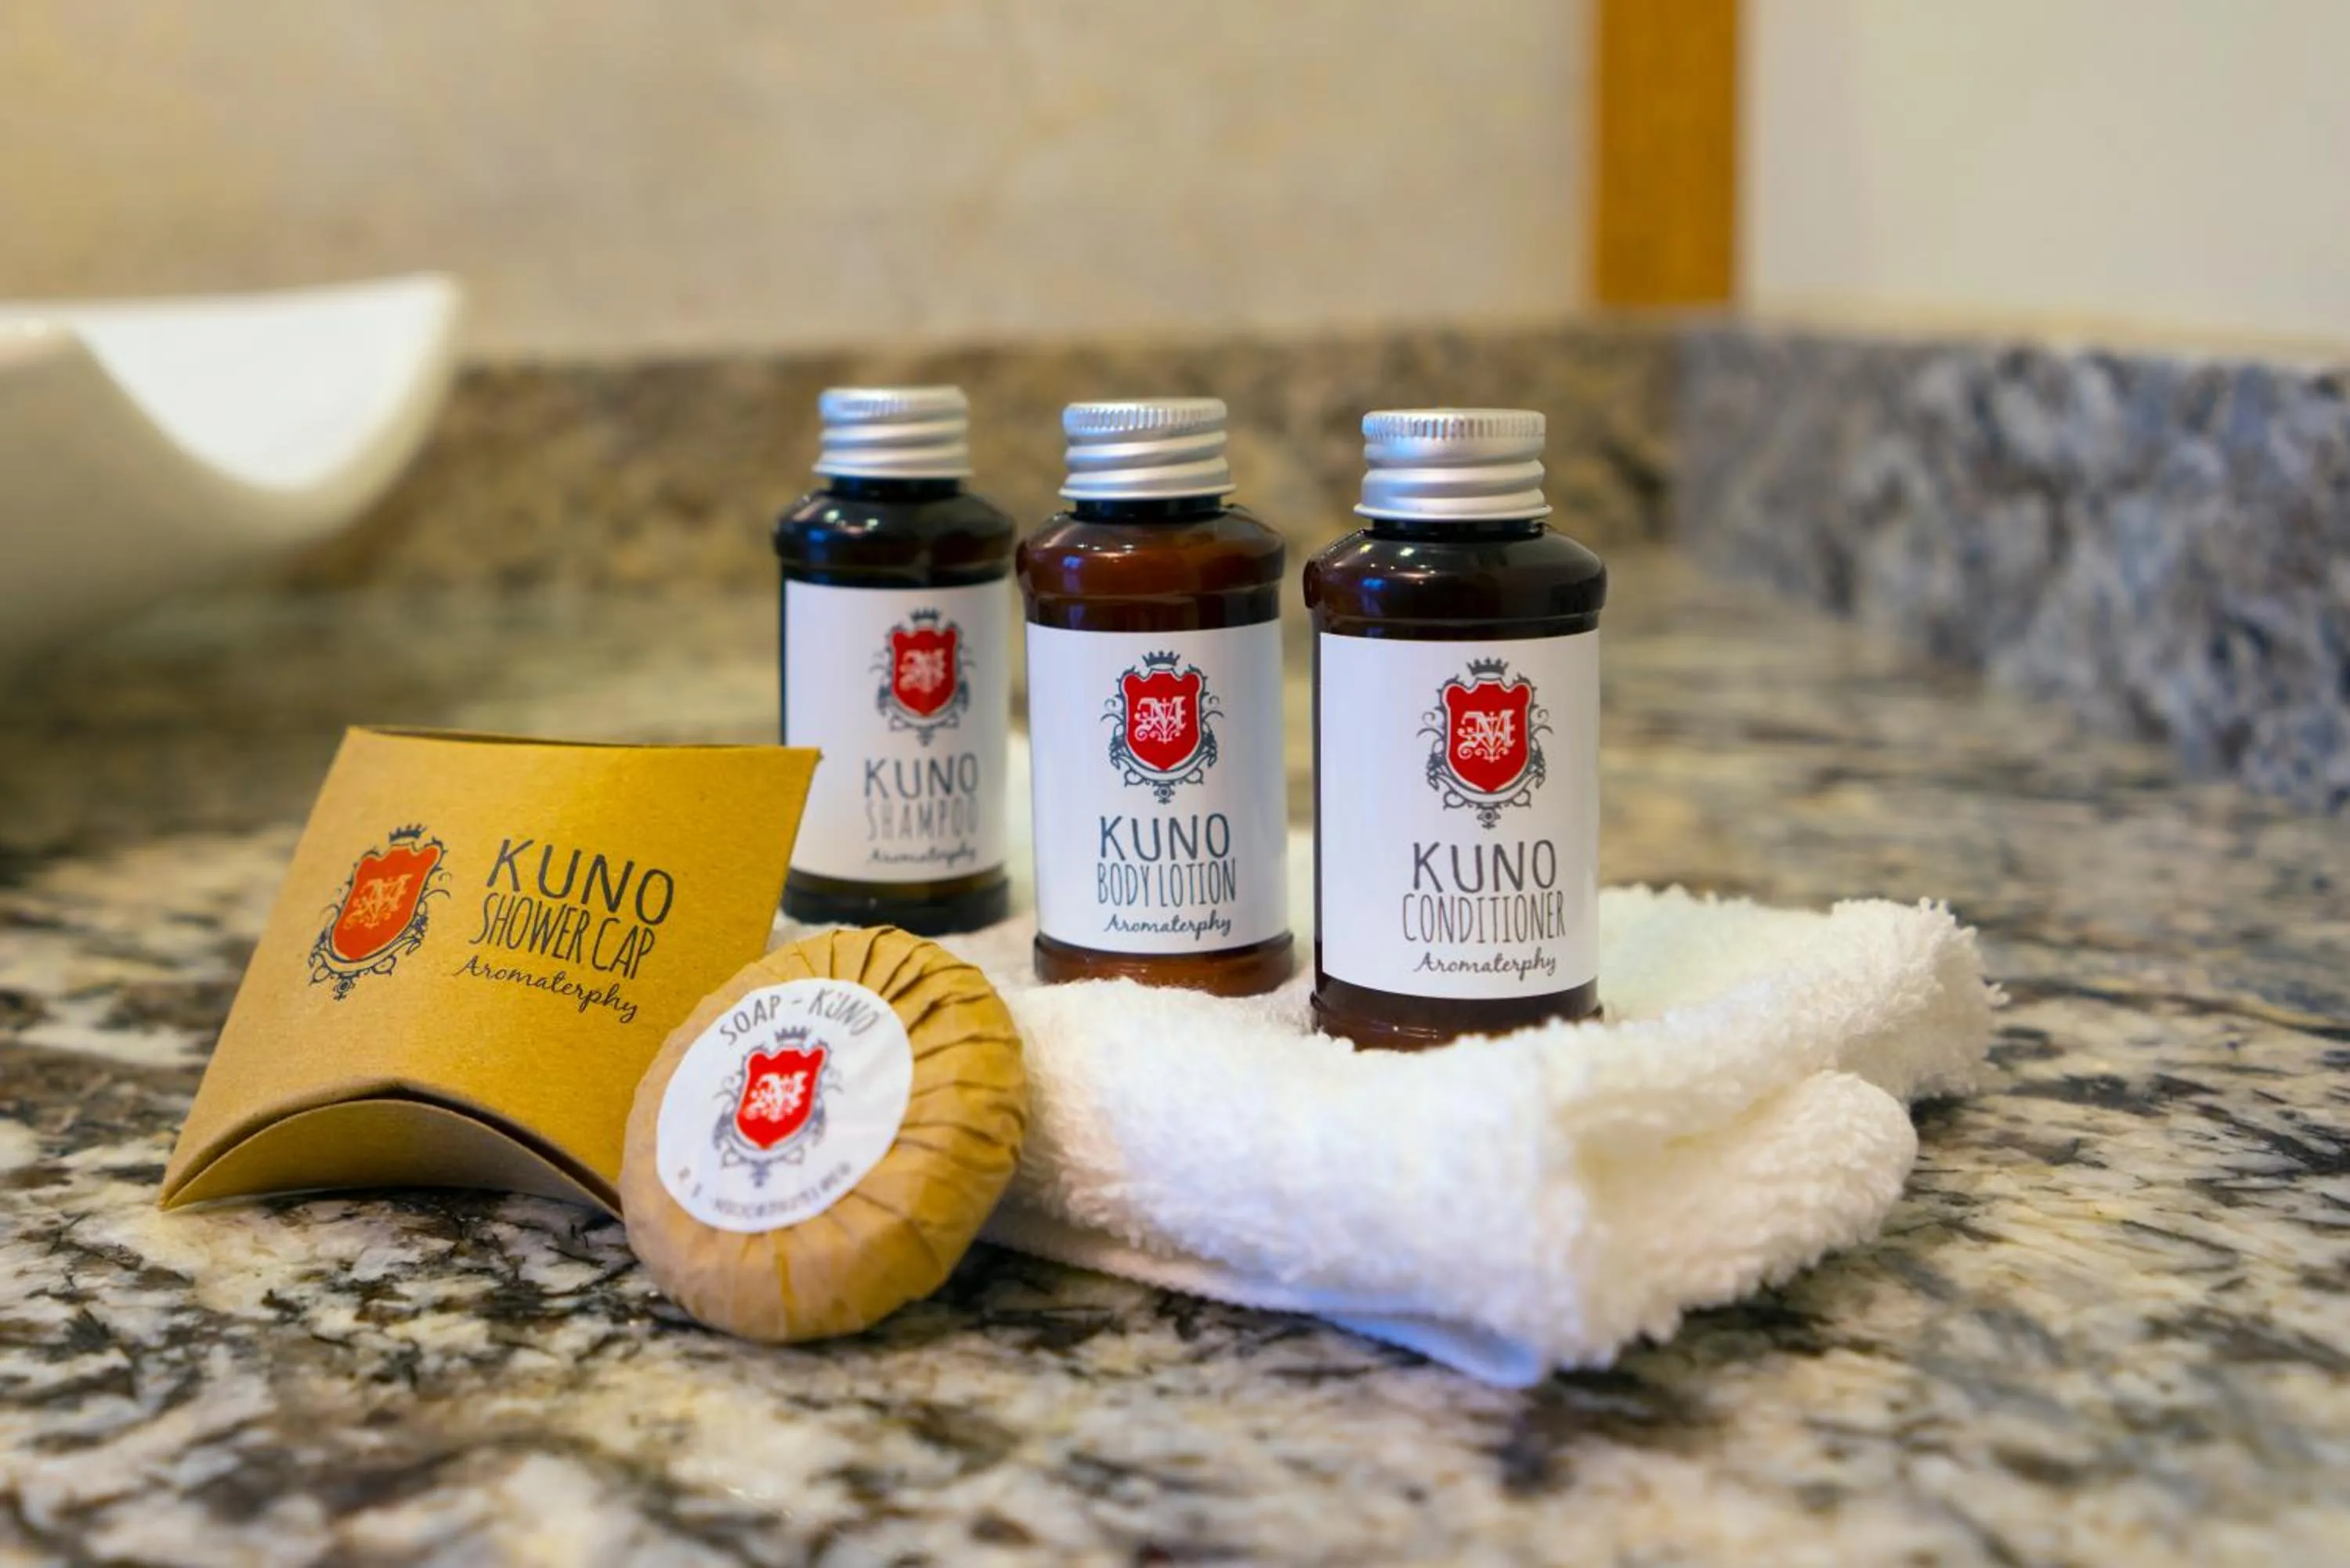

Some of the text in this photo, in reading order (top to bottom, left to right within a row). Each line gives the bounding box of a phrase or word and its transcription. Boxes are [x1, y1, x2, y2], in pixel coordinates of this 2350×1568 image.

[864, 752, 978, 798] KUNO
[1100, 813, 1231, 862] KUNO
[486, 838, 675, 926] KUNO
[1097, 858, 1237, 908] BODY LOTION
[1412, 840, 1556, 893] KUNO
[468, 891, 656, 980] SHOWER CAP
[1104, 909, 1232, 941] Aromaterphy
[1402, 891, 1566, 944] CONDITIONER
[453, 955, 638, 1024] Aromaterphy
[1412, 947, 1556, 982] Aromaterphy
[719, 993, 782, 1046] SOAP
